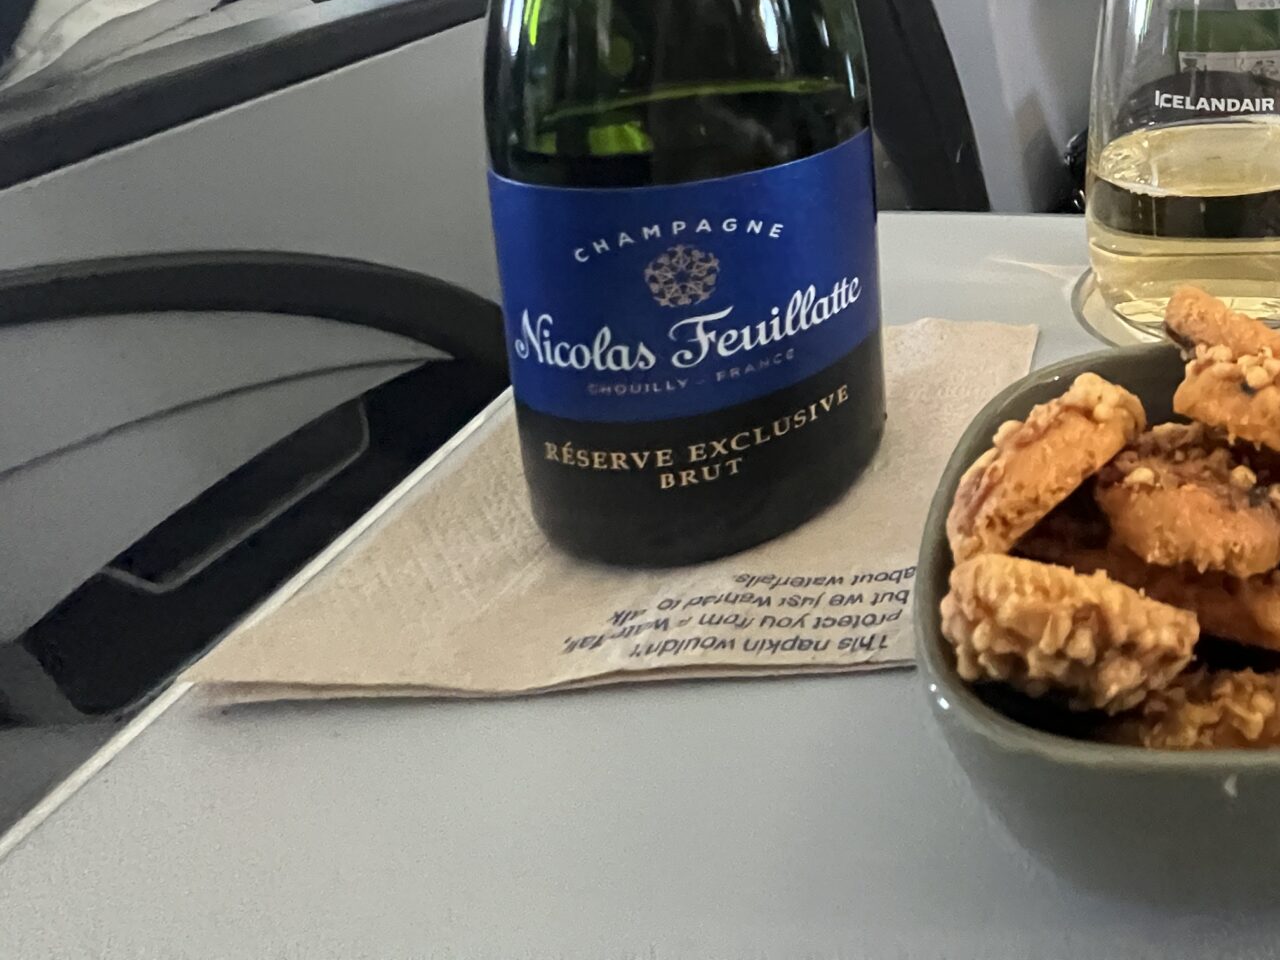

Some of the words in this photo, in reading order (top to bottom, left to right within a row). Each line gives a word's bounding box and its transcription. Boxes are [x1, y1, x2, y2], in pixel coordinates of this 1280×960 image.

[1155, 90, 1275, 112] ICELANDAIR
[574, 218, 784, 263] CHAMPAGNE
[515, 308, 657, 372] Nicolas
[668, 276, 862, 369] Feuillatte
[589, 378, 689, 397] CHOUILLY
[716, 348, 796, 383] FRANCE
[544, 441, 673, 471] RÉSERVE
[689, 384, 850, 463] EXCLUSIVE
[660, 458, 742, 490] BRUT
[850, 565, 918, 587] about
[778, 591, 826, 609] just
[828, 593, 864, 607] we
[870, 589, 911, 607] but
[698, 612, 754, 631] from
[760, 612, 811, 630] you
[812, 609, 903, 629] protect
[743, 635, 831, 656] napkin
[837, 634, 889, 654] This
